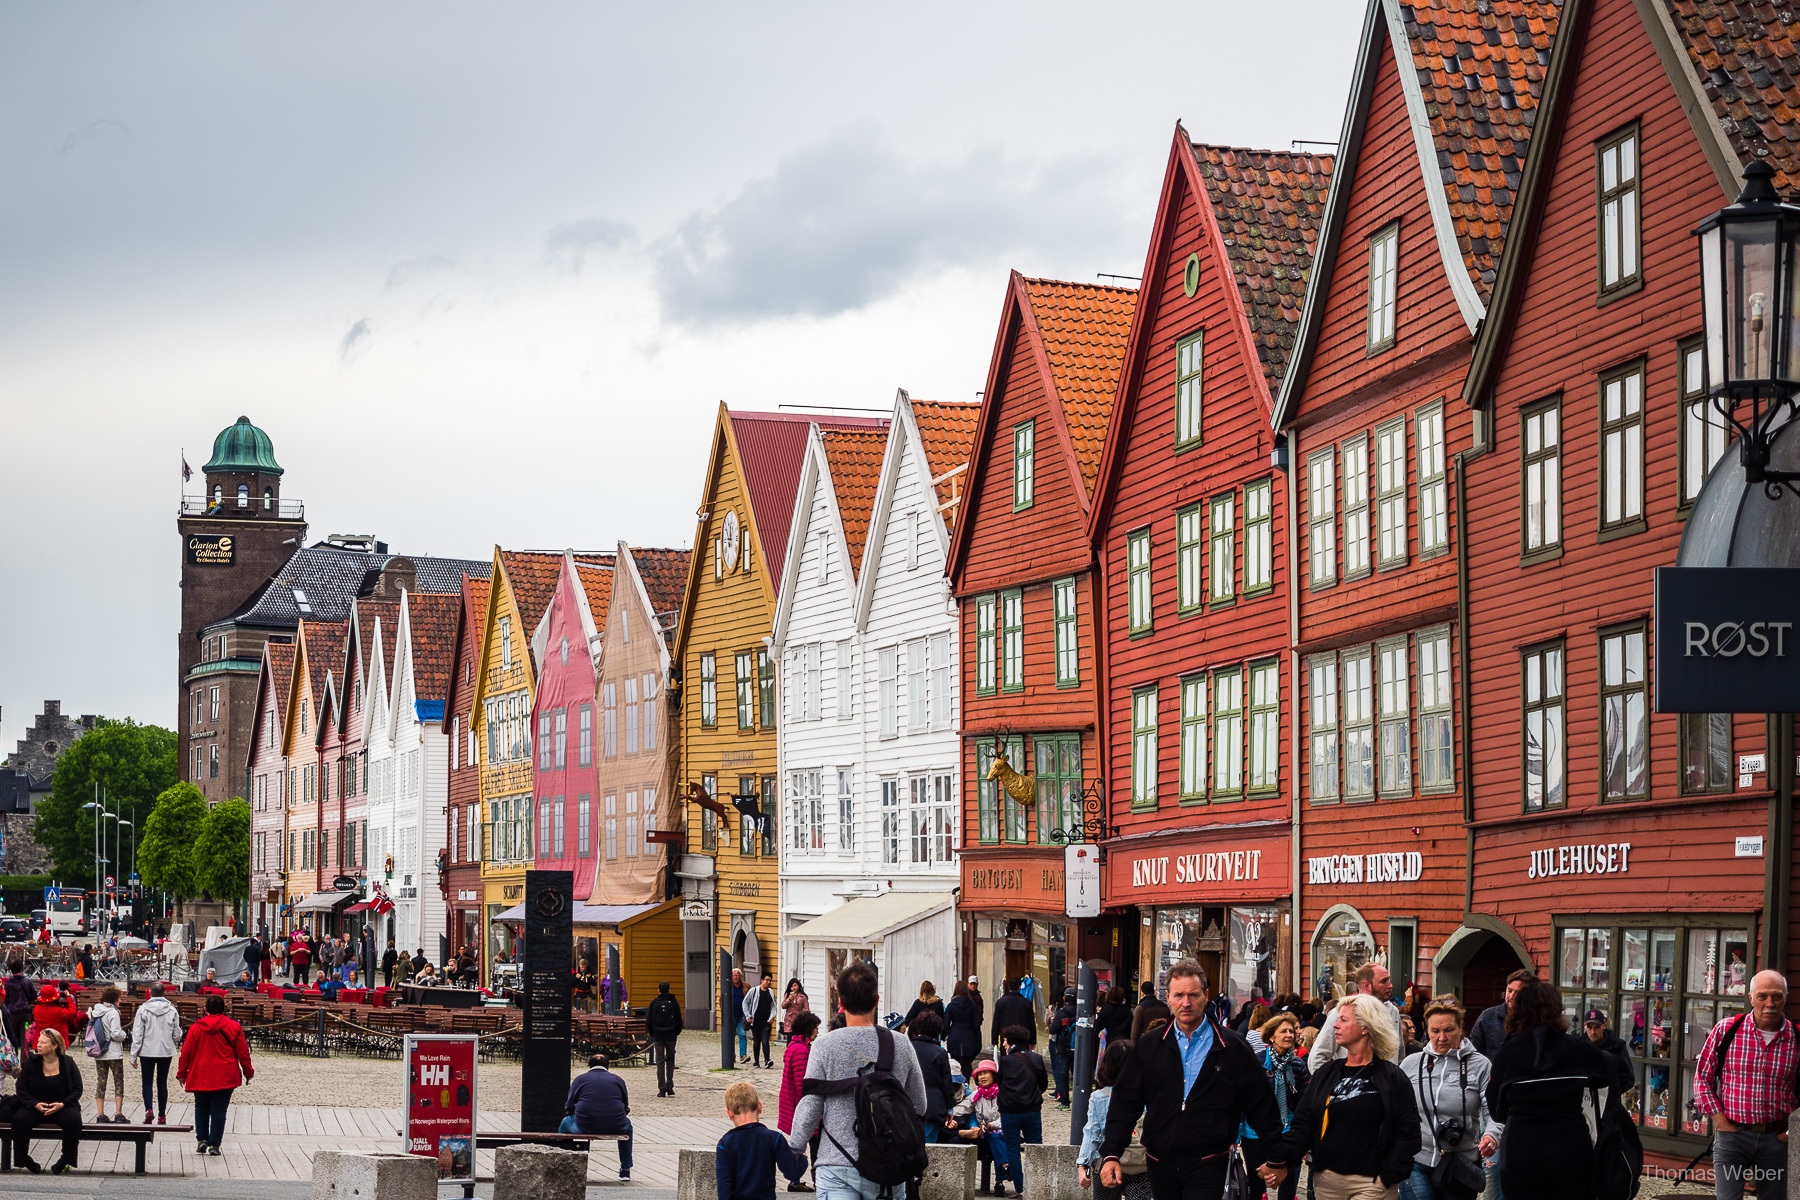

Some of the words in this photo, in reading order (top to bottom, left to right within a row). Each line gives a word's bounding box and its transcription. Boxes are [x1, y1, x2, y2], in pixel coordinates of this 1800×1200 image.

[190, 538, 218, 549] Clarion
[196, 549, 232, 557] Collection
[1683, 621, 1793, 658] RØST
[1741, 758, 1761, 772] Bryggen
[1133, 857, 1169, 887] KNUT
[1176, 850, 1262, 883] SKURTVEIT
[1308, 854, 1364, 884] BRYGGEN
[1366, 851, 1423, 882] HUSFLID
[1528, 843, 1631, 879] JULEHUSET
[972, 868, 1023, 889] BRYGGEN
[421, 1065, 449, 1085] HH
